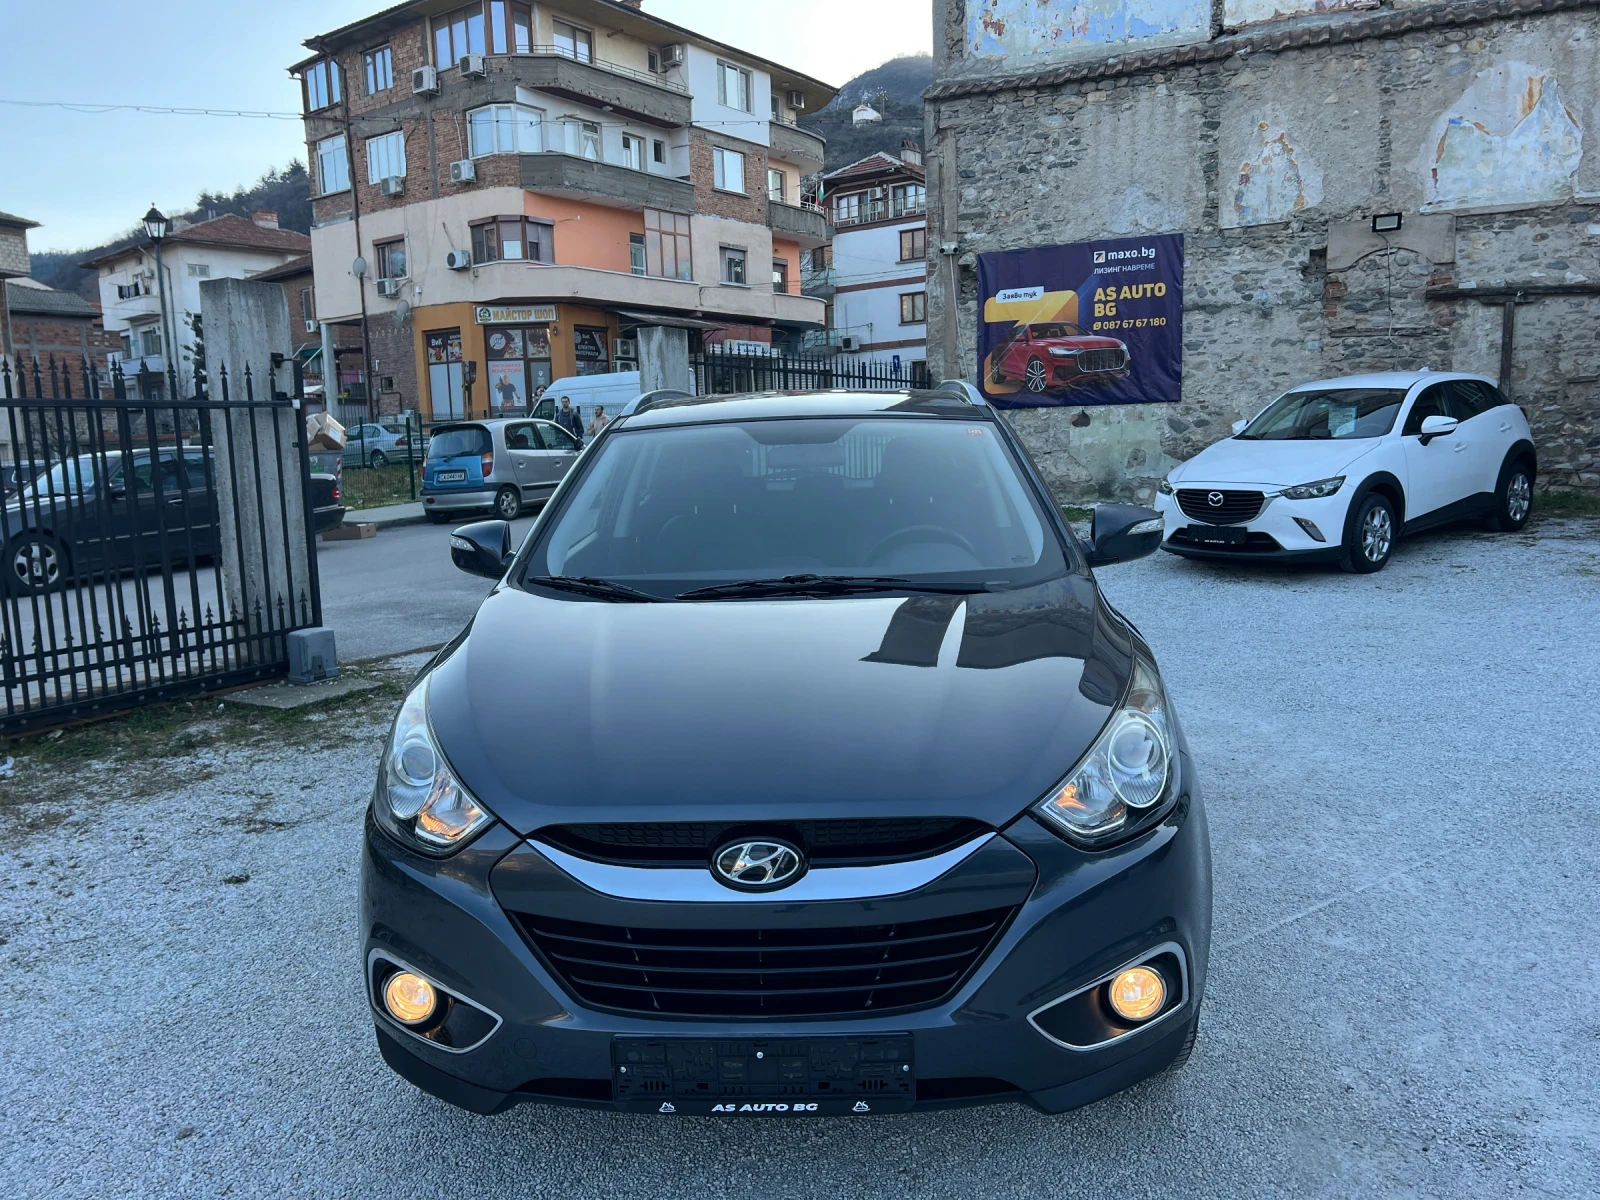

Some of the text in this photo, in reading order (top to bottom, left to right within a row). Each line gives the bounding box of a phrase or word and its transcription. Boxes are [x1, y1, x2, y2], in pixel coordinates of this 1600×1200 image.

[1108, 246, 1156, 260] maxo.bg
[1094, 263, 1156, 275] ЛИЗИНГ НАВРЕМЕ
[1094, 282, 1166, 302] AS AUTO
[492, 308, 555, 321] МАЙСТОР ШОП
[1094, 302, 1117, 317] BG
[1103, 317, 1167, 330] 087 67 67 180
[711, 1103, 818, 1112] AS AUTO BG
